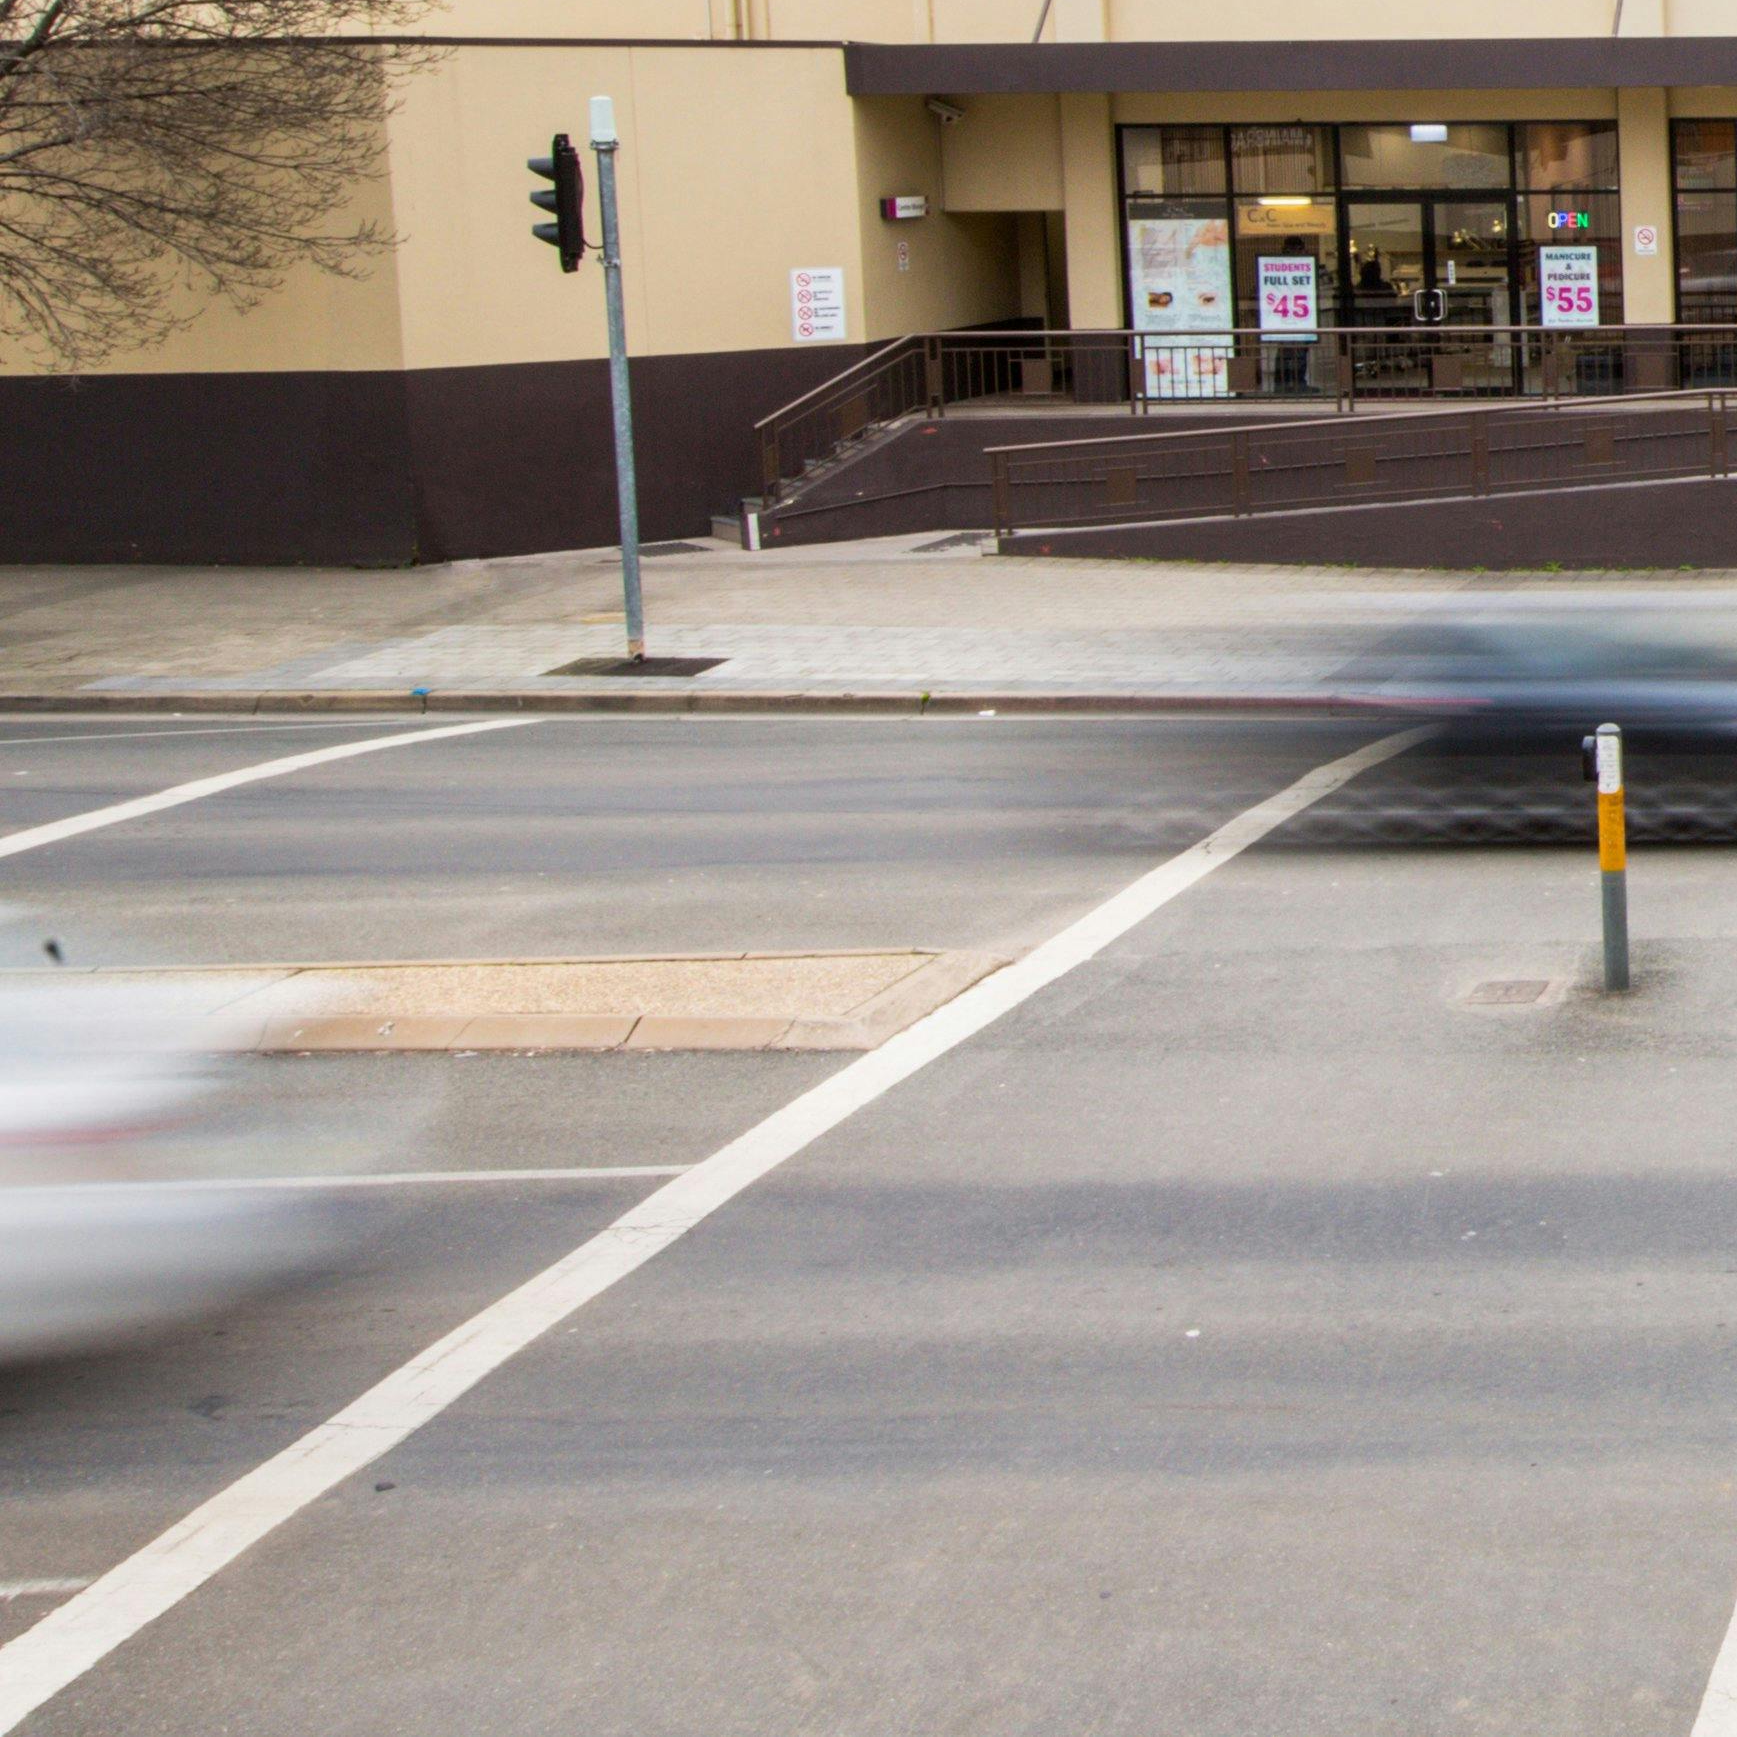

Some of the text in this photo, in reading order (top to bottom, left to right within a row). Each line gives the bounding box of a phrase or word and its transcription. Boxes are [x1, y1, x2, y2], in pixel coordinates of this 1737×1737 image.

[1548, 212, 1589, 228] OPEN
[1263, 263, 1311, 272] STUDENTS
[1264, 276, 1311, 285] FULL SET
[1266, 293, 1310, 318] $45
[1546, 285, 1593, 312] $55
